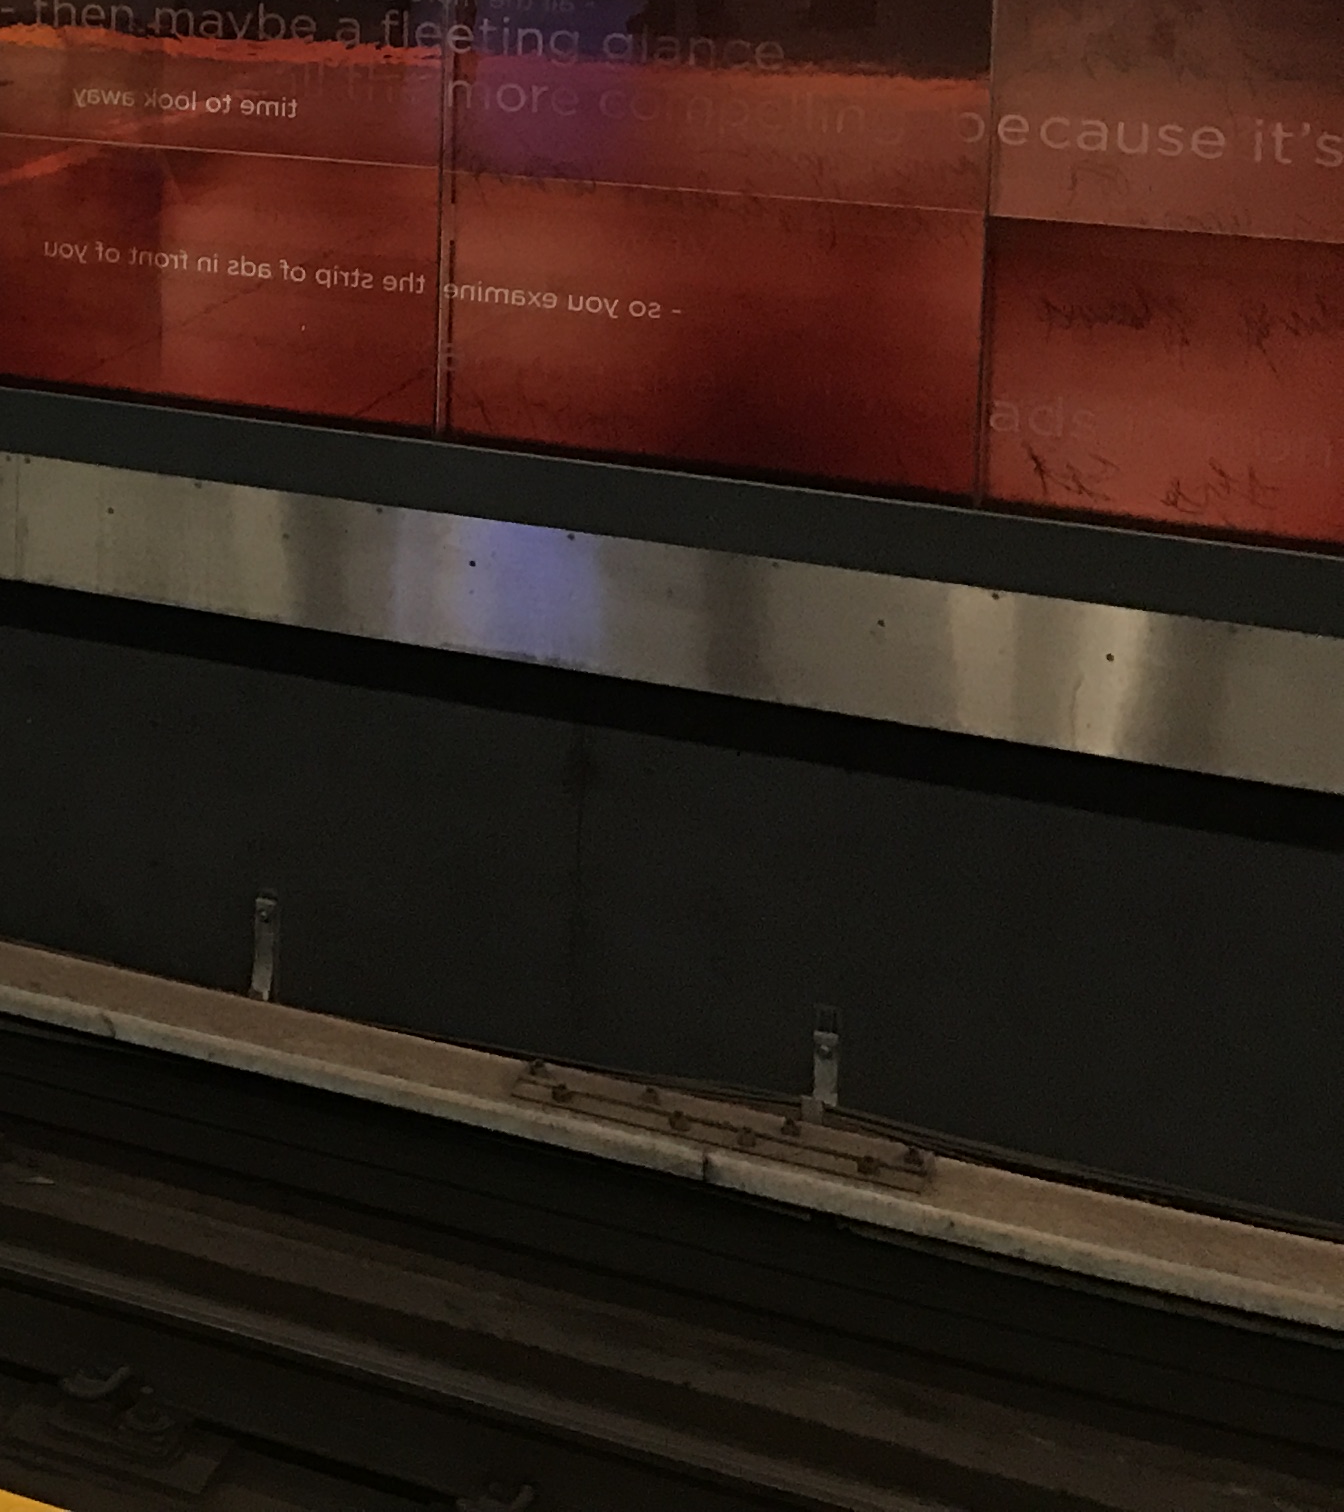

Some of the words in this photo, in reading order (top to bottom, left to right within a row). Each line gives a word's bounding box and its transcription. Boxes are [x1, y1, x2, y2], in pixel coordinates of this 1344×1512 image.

[153, 1, 318, 44] maybe
[335, 16, 361, 49] a
[381, 7, 580, 65] fleeting
[447, 76, 579, 118] more
[1252, 113, 1344, 169] it's
[987, 395, 1098, 441] ads
